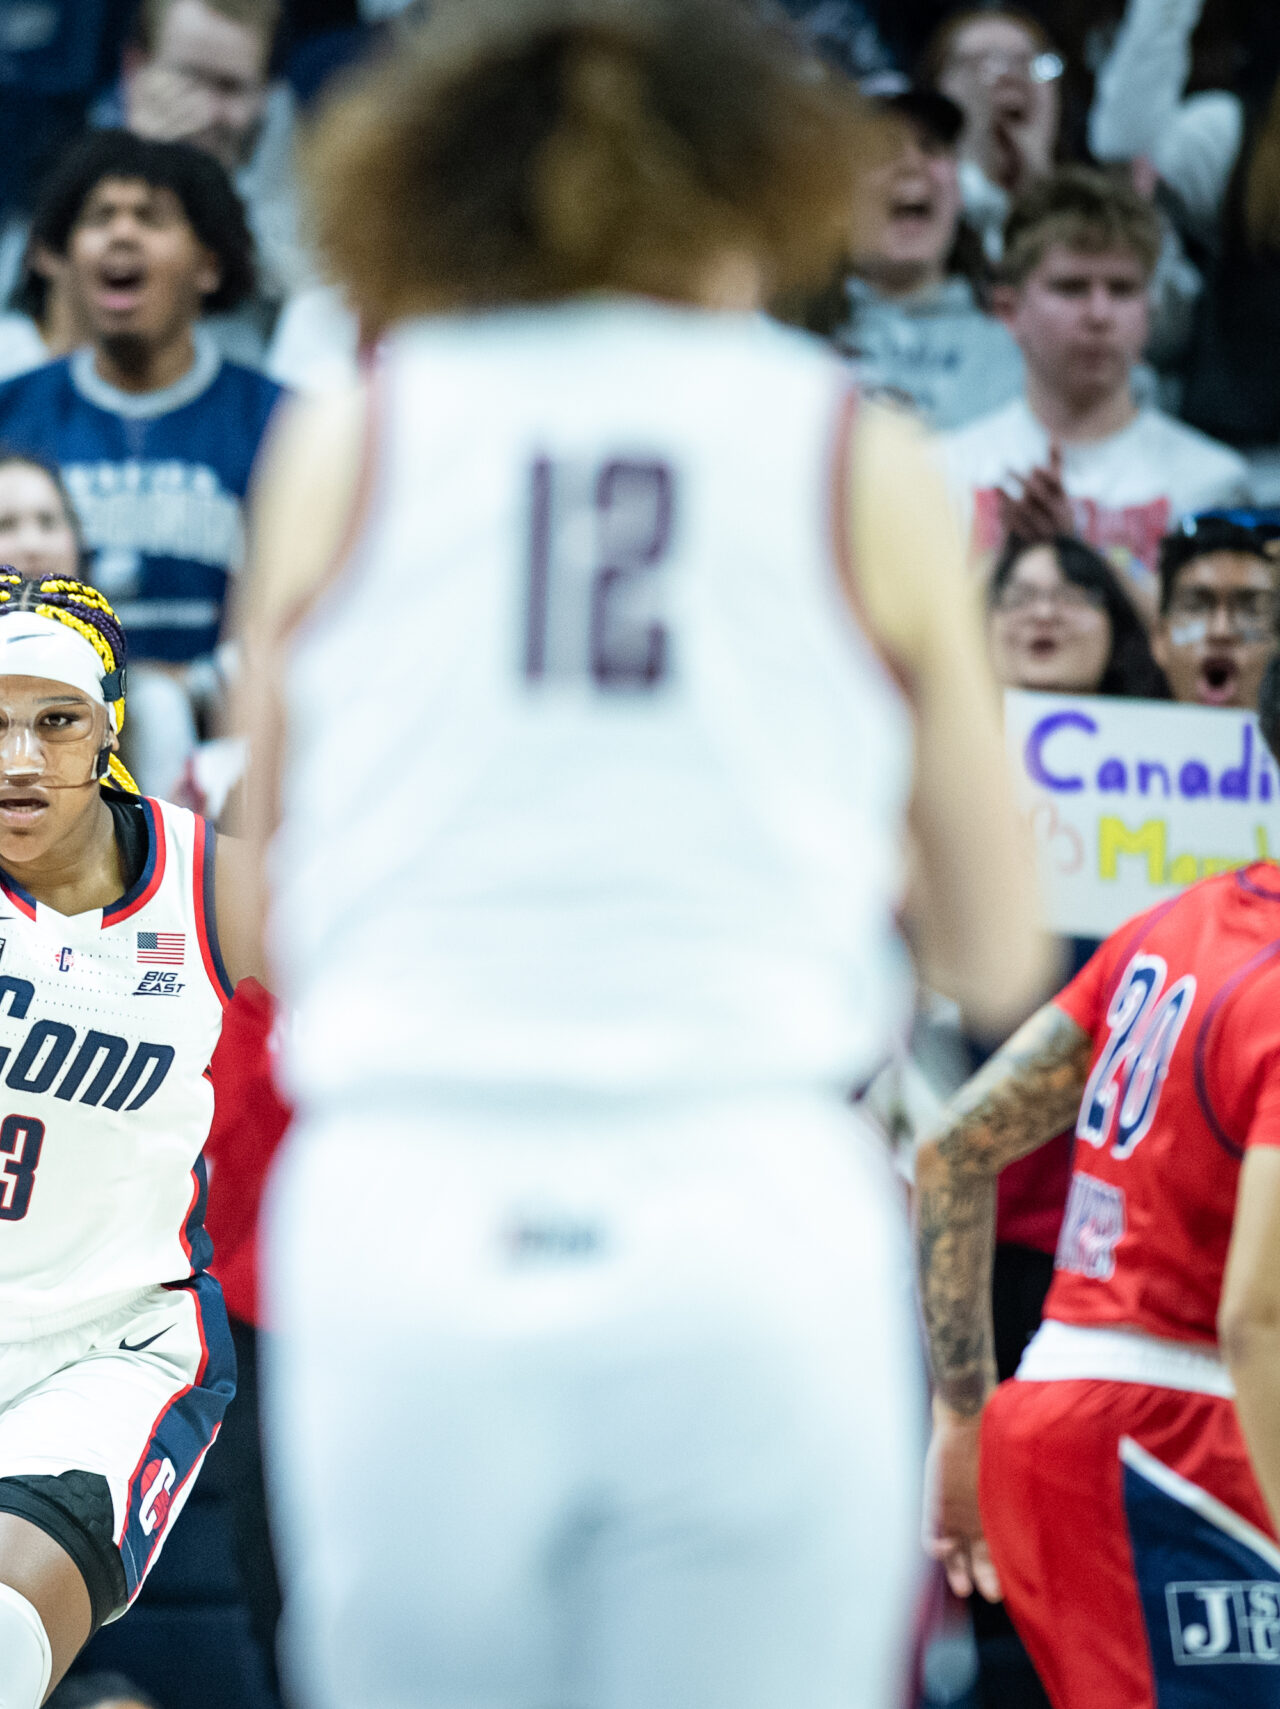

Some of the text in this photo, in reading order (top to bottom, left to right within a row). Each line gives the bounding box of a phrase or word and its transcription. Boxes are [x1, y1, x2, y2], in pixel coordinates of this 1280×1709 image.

[522, 453, 675, 696] 12
[1023, 709, 1280, 803] Canadi
[136, 981, 186, 994] EAST
[142, 971, 179, 983] BIG
[1075, 949, 1198, 1161] 20
